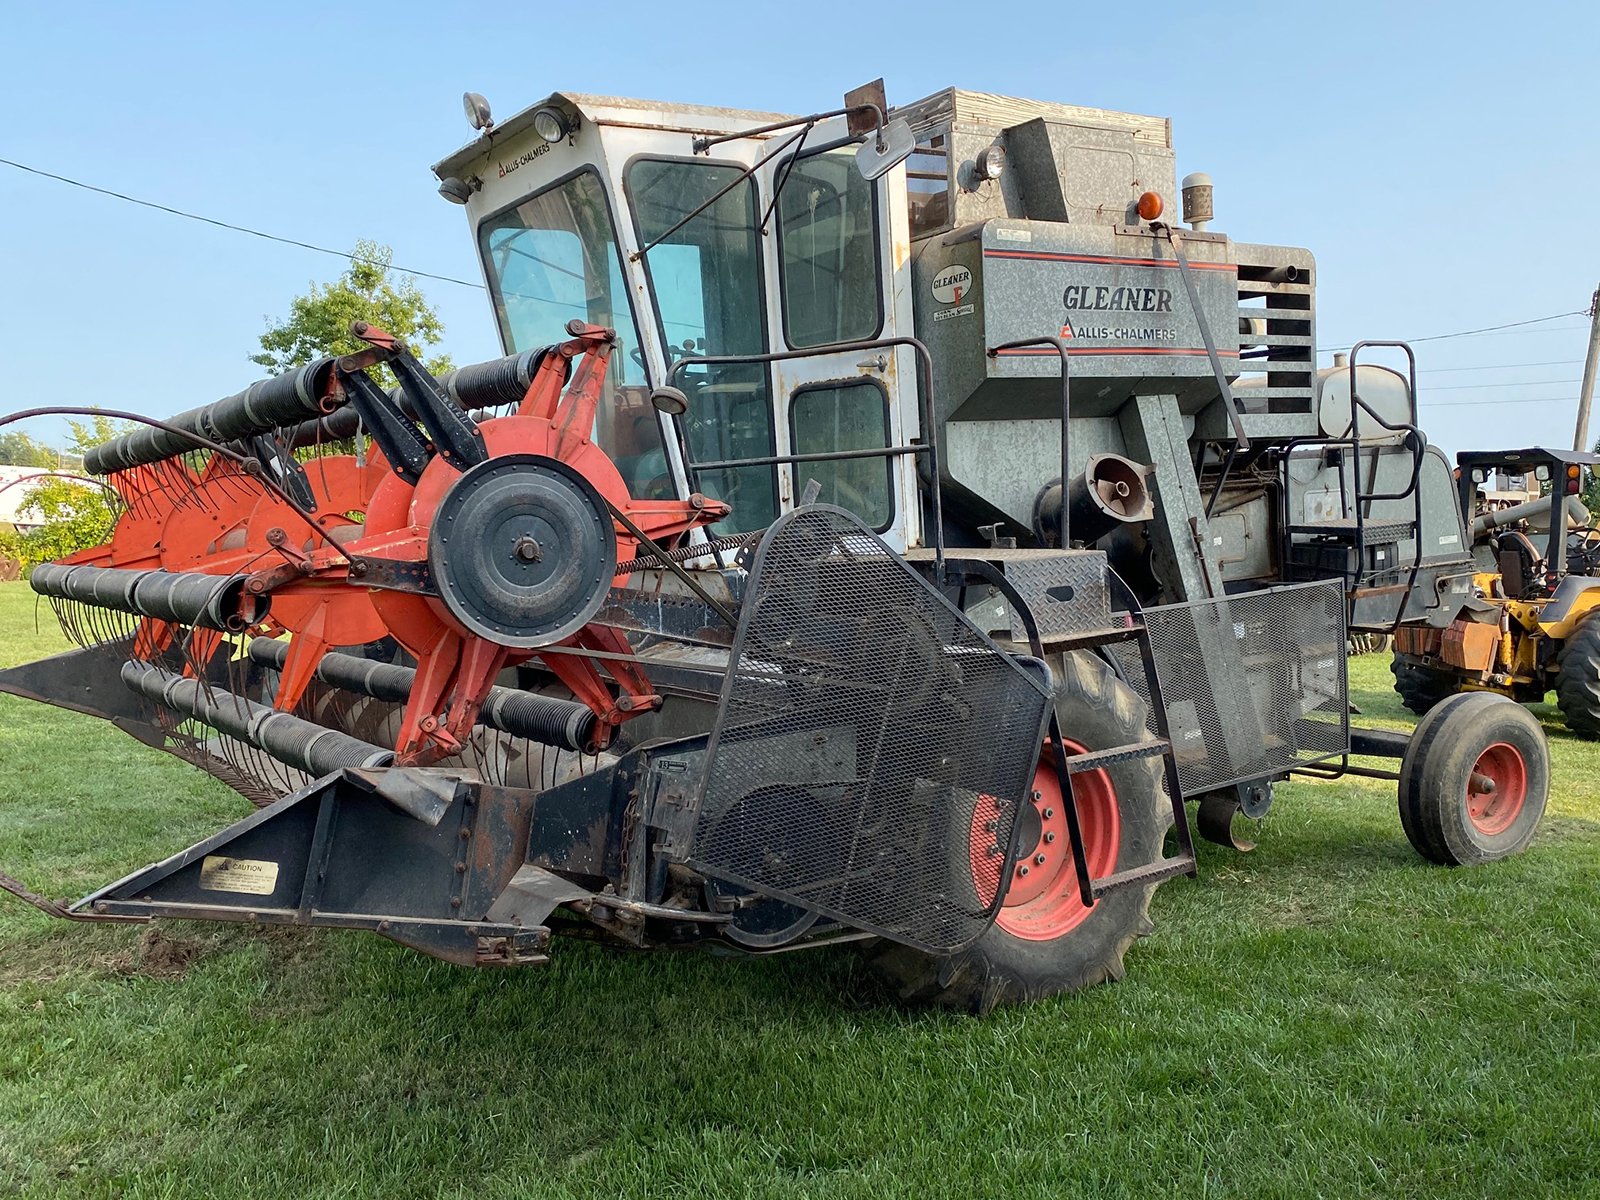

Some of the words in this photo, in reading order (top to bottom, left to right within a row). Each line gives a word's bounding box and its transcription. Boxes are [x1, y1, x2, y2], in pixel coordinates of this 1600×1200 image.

[504, 142, 551, 174] ALLIS-CHALMERS
[933, 271, 970, 290] GLEANER
[1062, 285, 1173, 312] GLEANER
[1077, 327, 1176, 340] ALLIS-CHALMERS
[232, 863, 263, 872] CAUTION
